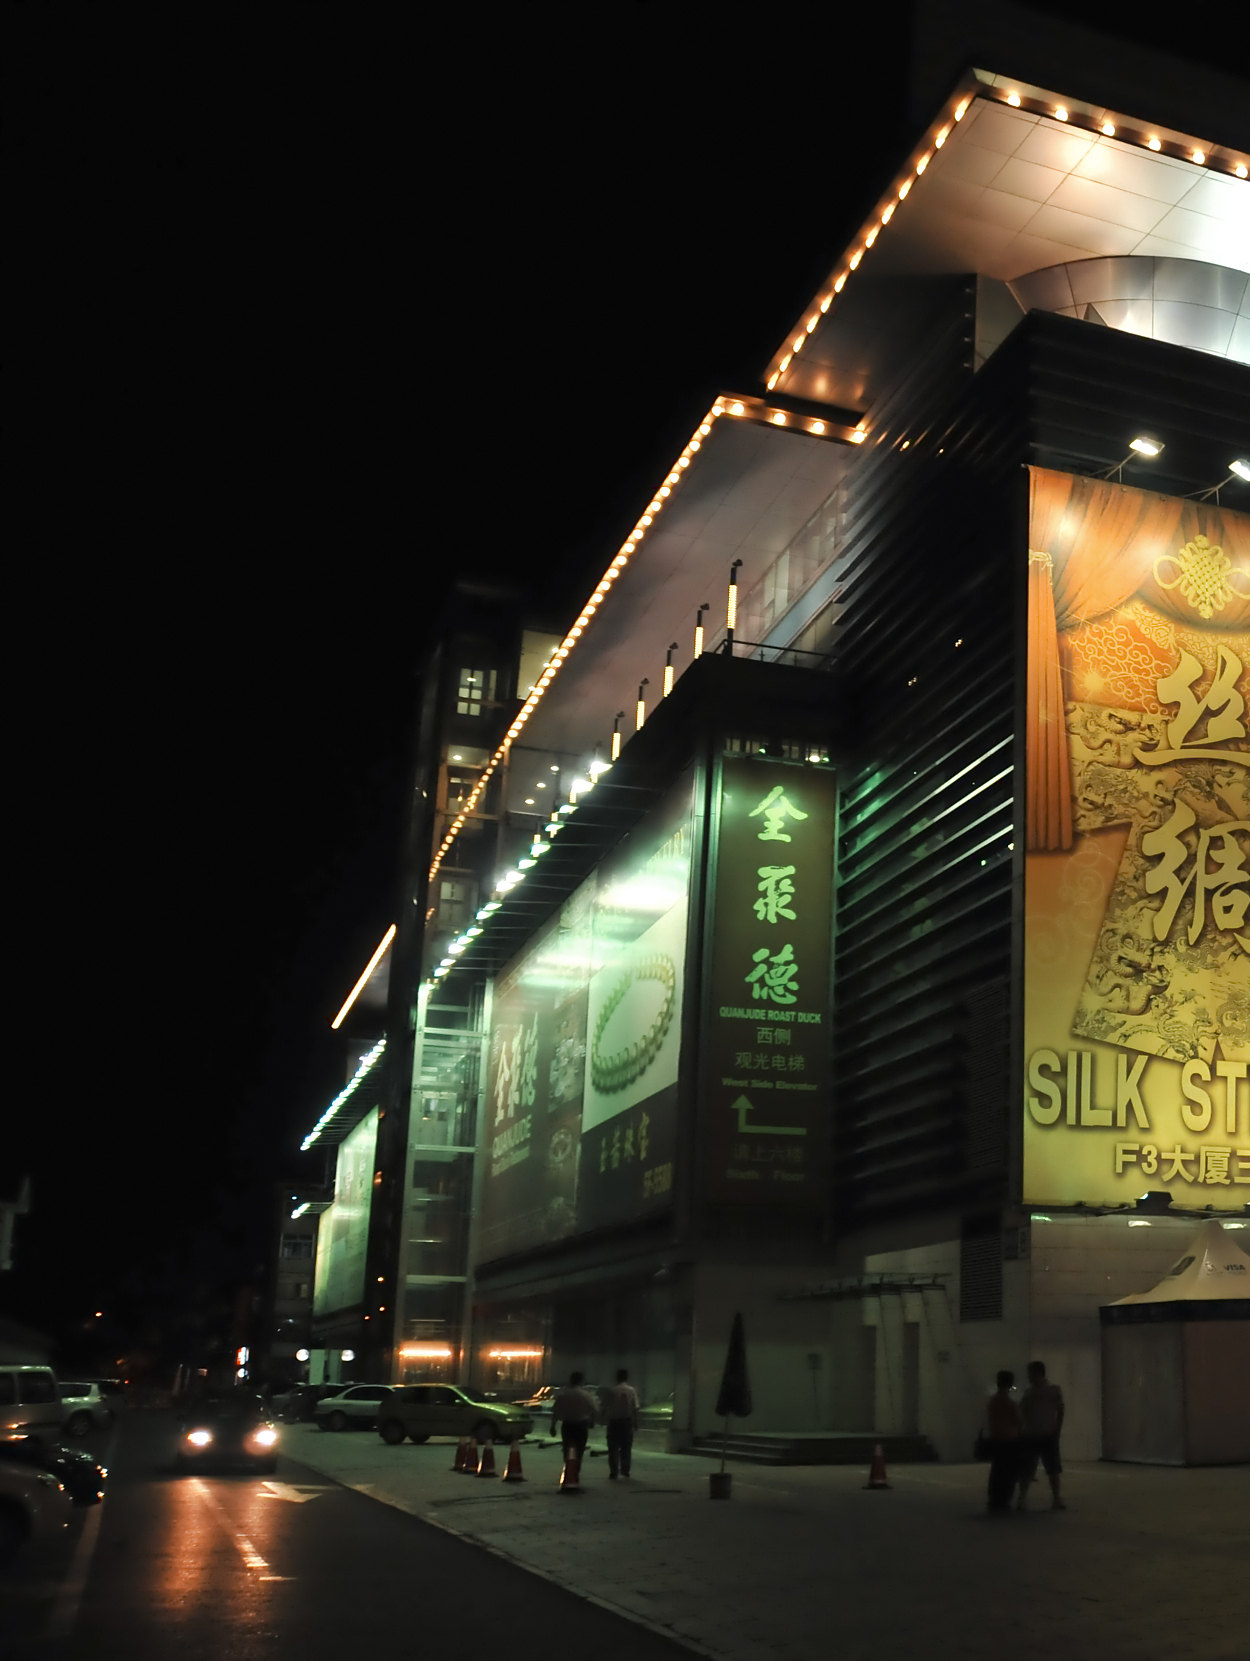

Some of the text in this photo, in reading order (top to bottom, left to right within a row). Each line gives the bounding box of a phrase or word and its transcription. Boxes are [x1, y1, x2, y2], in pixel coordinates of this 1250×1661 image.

[744, 785, 809, 1005] 全聚德
[719, 1006, 822, 1024] QUANJUDE ROAST DUCK
[756, 1026, 792, 1046] 西侧
[734, 1051, 805, 1072] 观光电梯
[721, 1077, 749, 1088] West
[750, 1079, 774, 1089] Side
[1028, 1048, 1150, 1129] SILK
[1223, 1264, 1246, 1272] VISA
